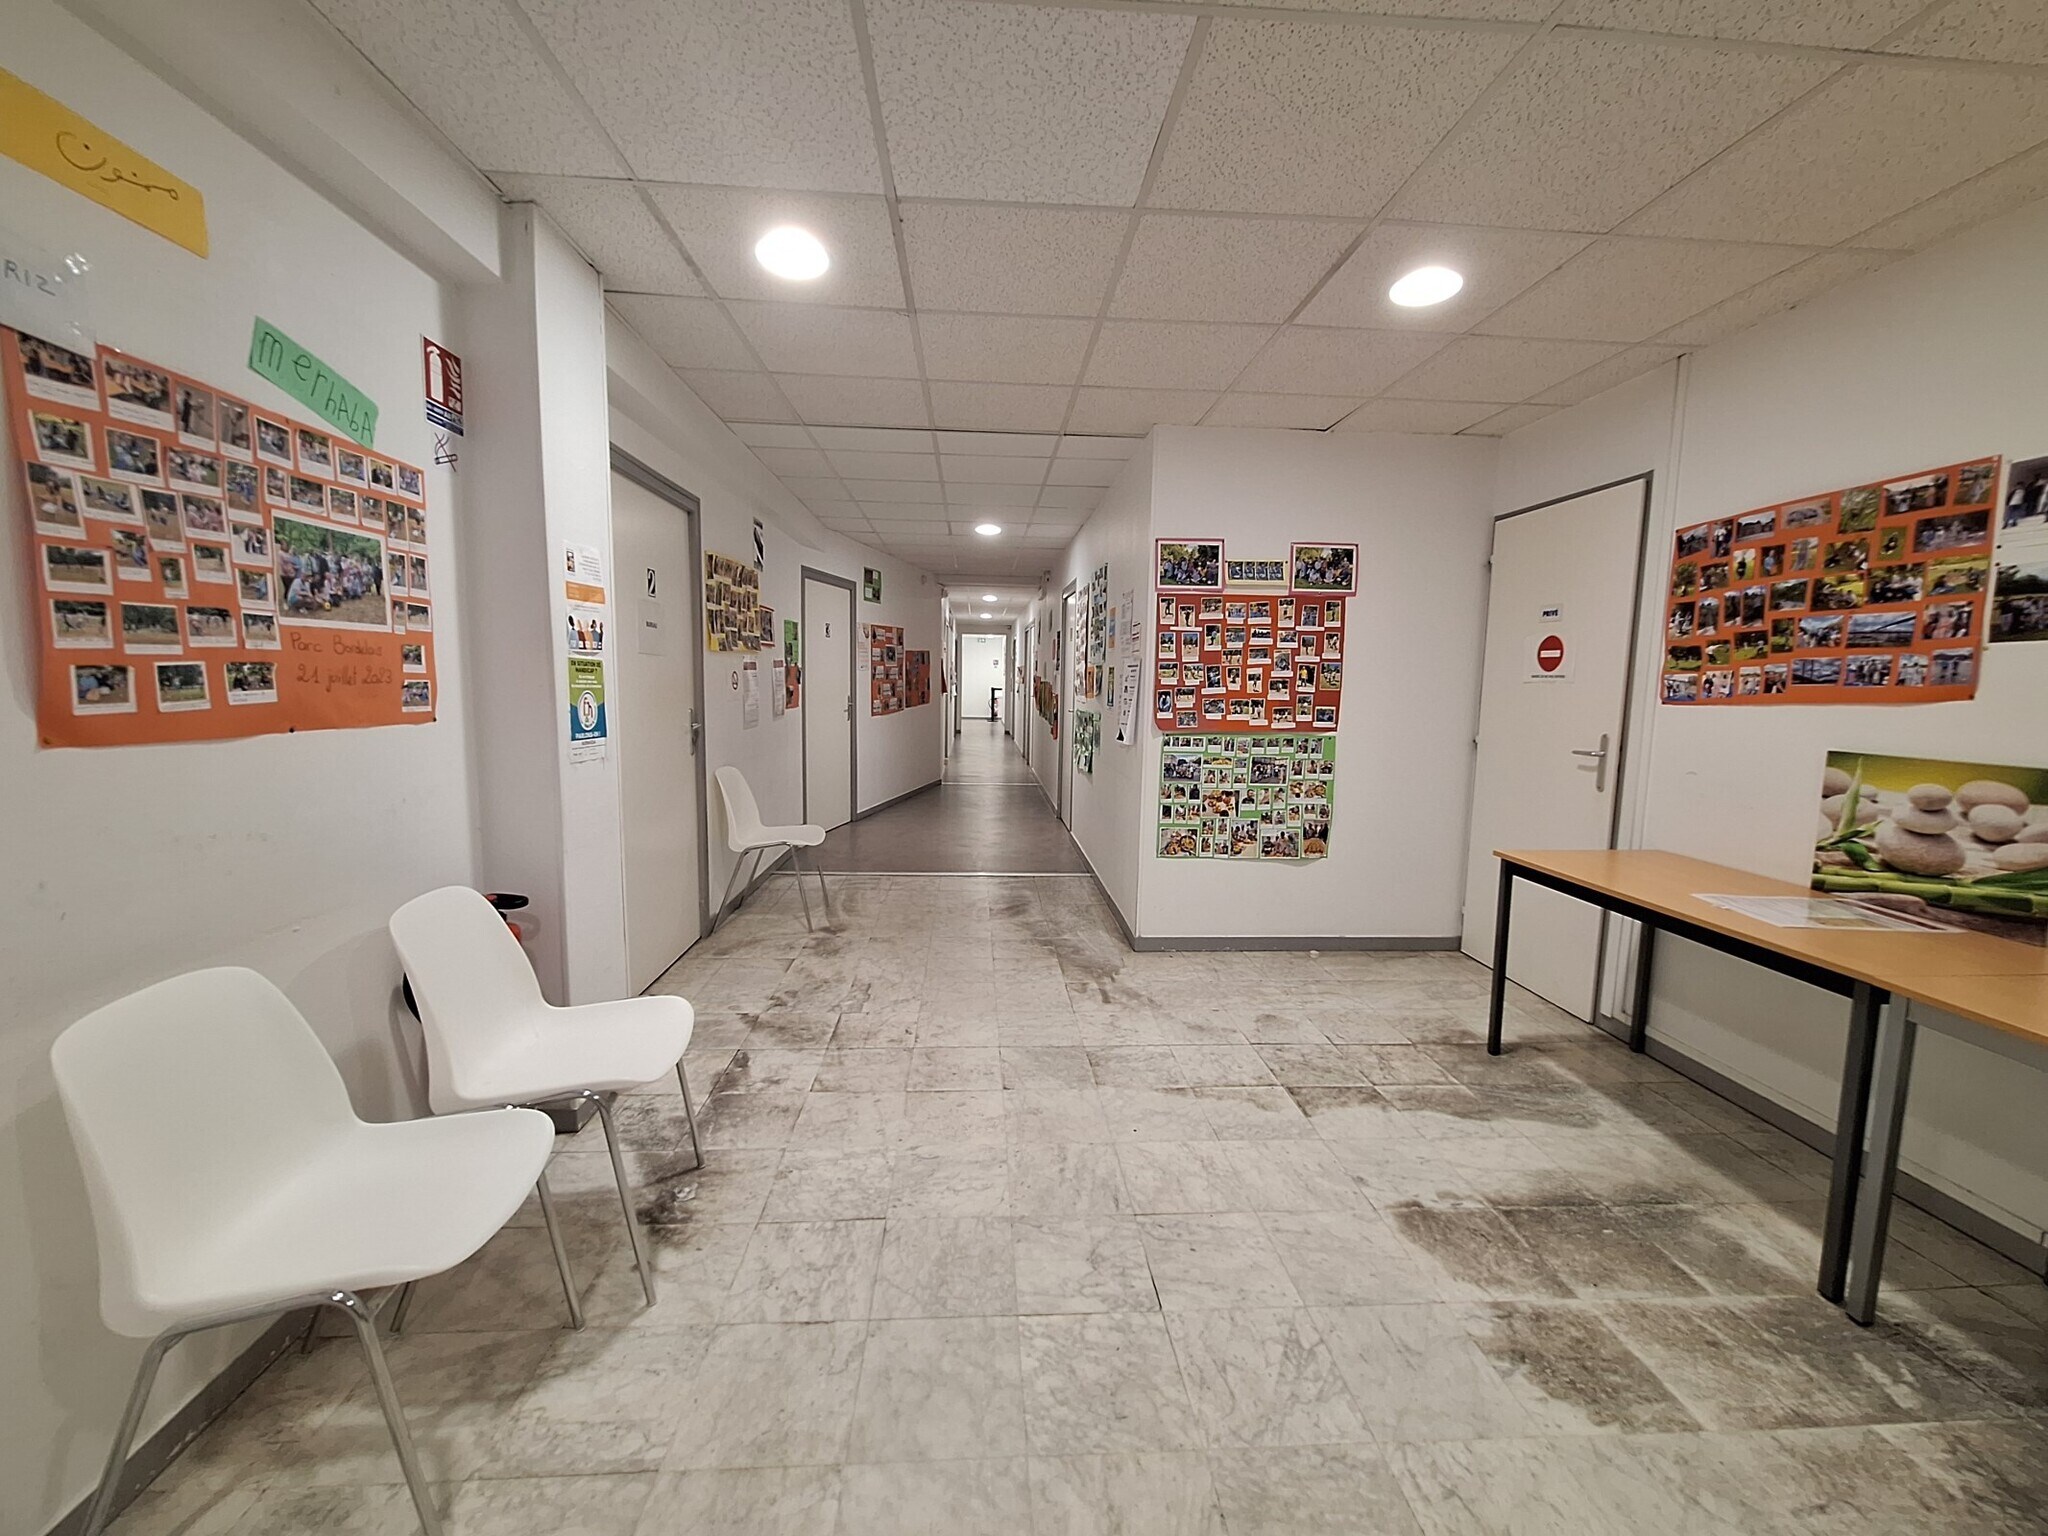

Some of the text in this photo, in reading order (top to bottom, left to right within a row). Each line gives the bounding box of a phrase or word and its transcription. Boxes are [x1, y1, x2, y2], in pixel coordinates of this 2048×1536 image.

[647, 569, 656, 597] 2
[289, 631, 322, 653] Parc
[296, 662, 320, 684] 21
[361, 664, 393, 685] 2023
